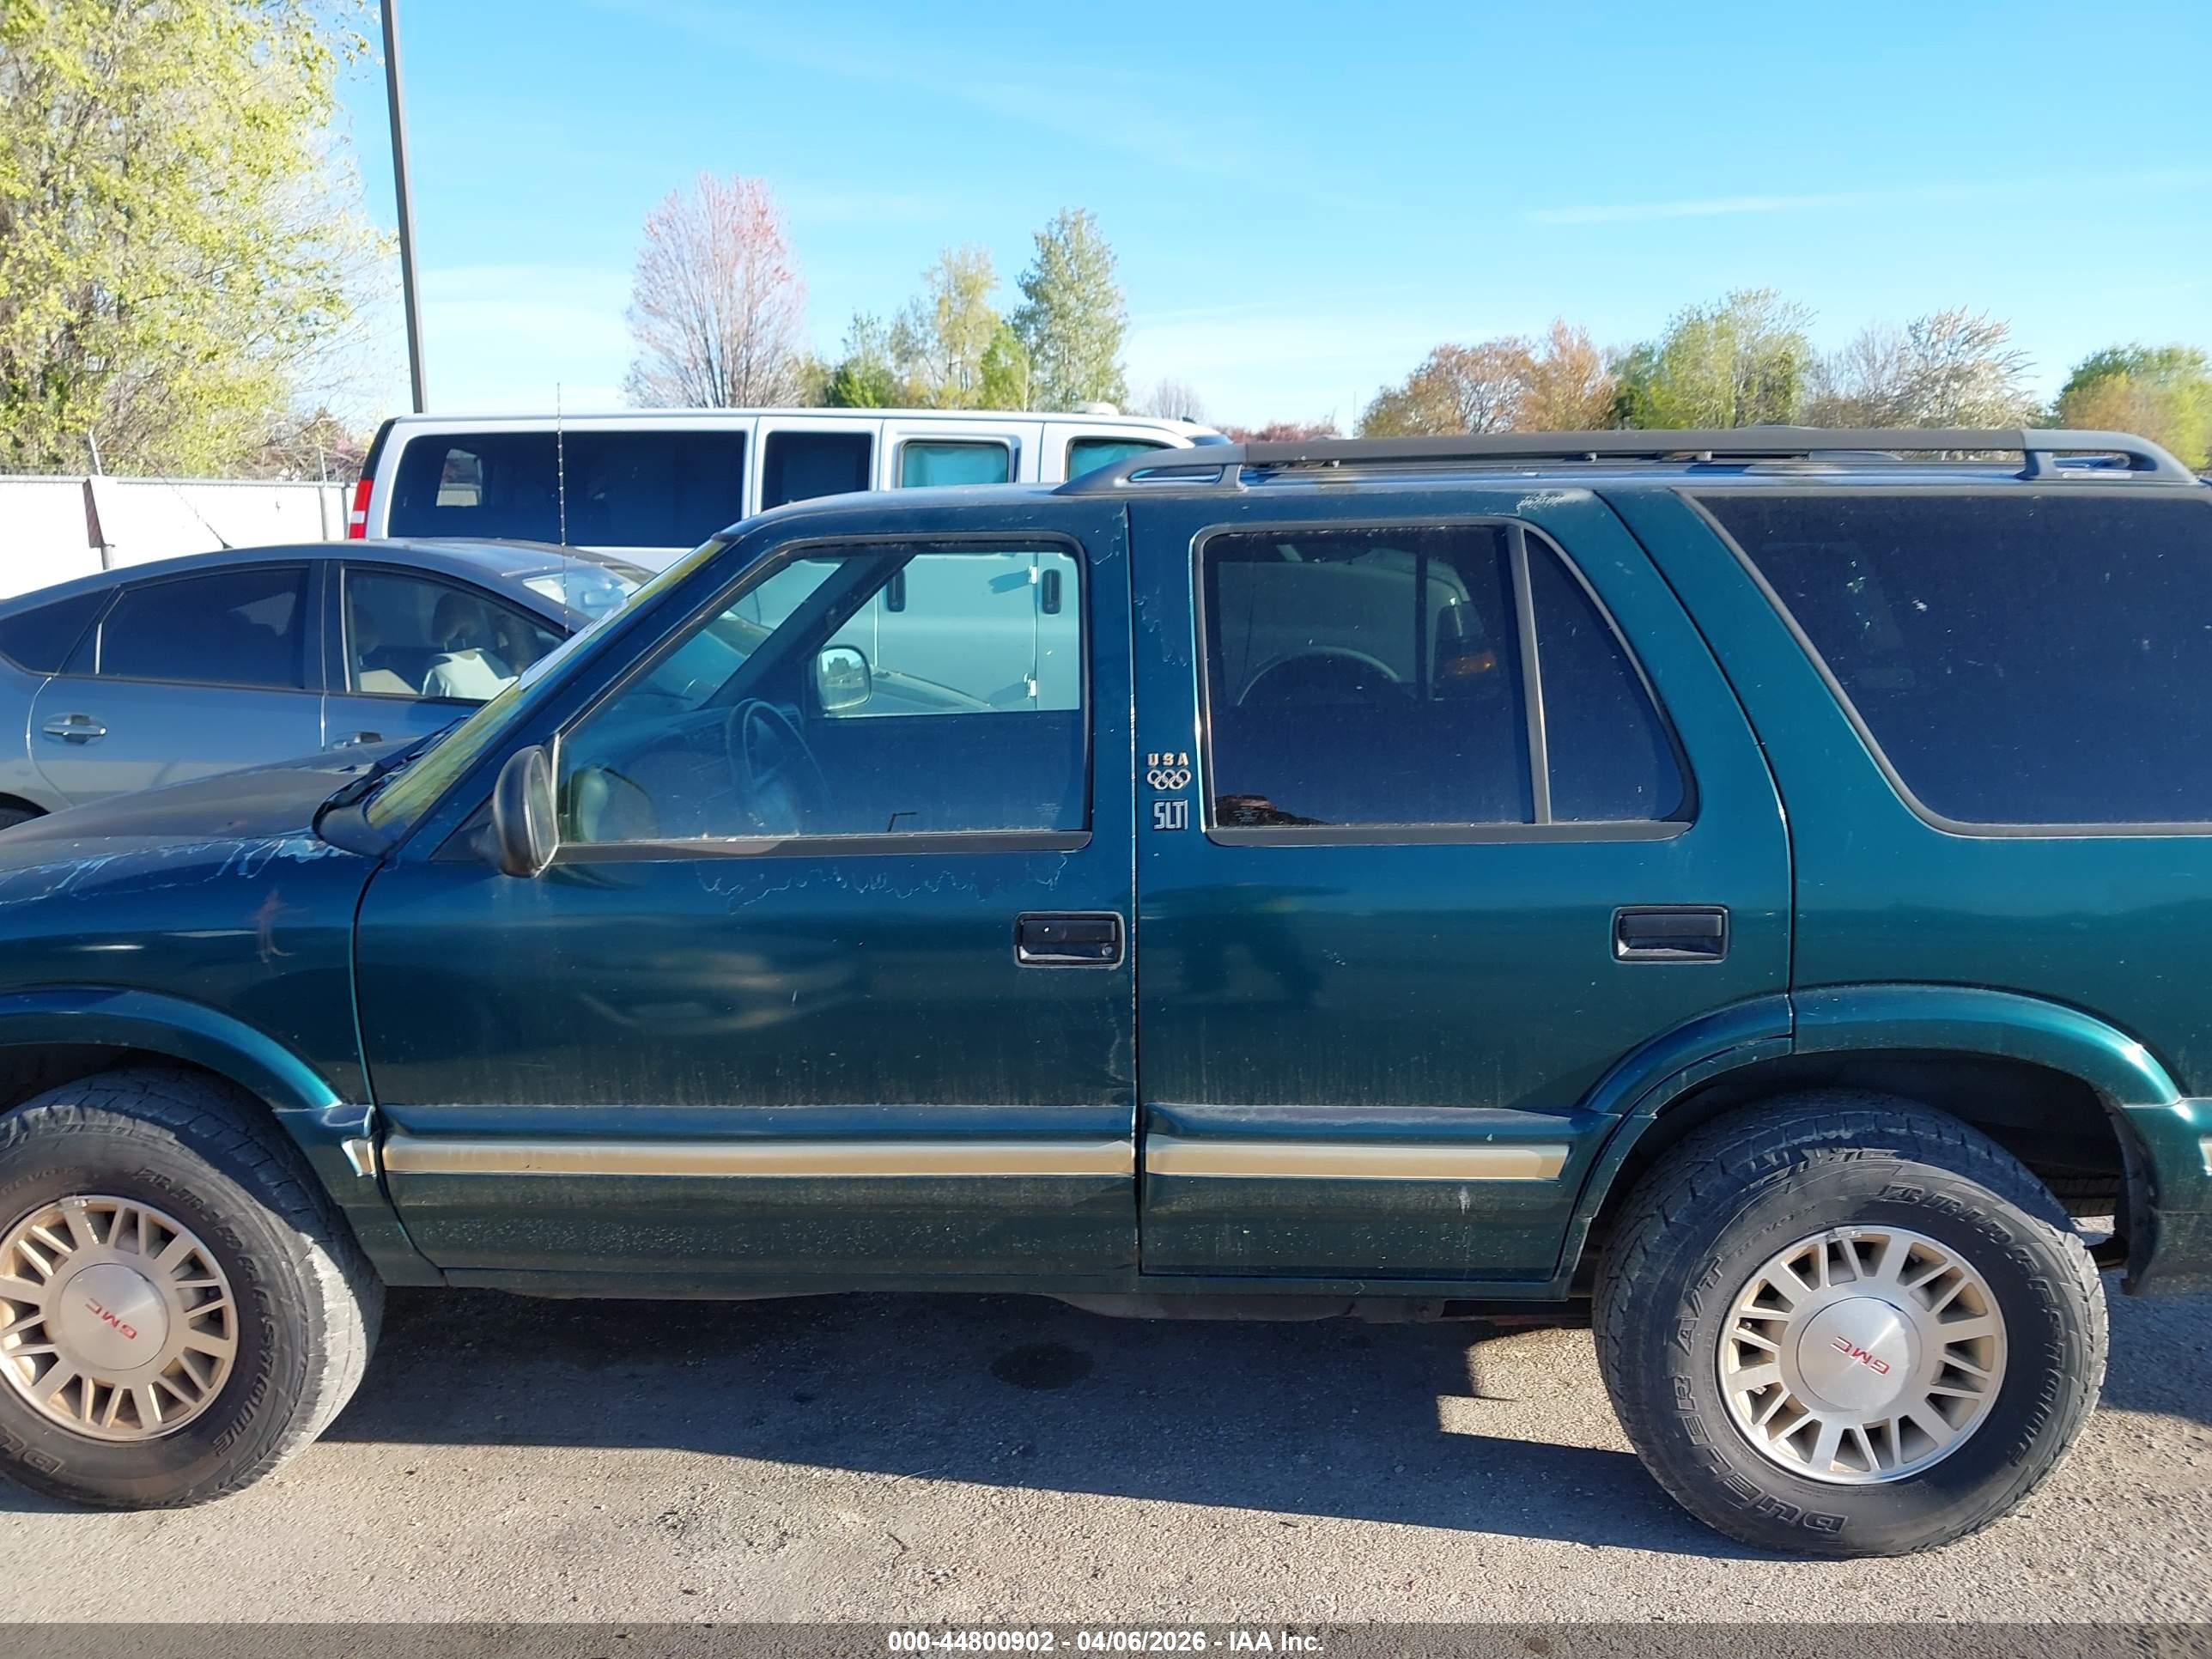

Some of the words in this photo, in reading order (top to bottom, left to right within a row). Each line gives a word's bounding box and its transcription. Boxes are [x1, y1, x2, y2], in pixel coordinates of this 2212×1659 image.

[1147, 752, 1189, 767] USA
[84, 1297, 138, 1340] GMC
[1676, 1253, 1724, 1357] A/T
[1829, 1335, 1891, 1376] GMC
[1674, 1374, 1849, 1534] DUELER
